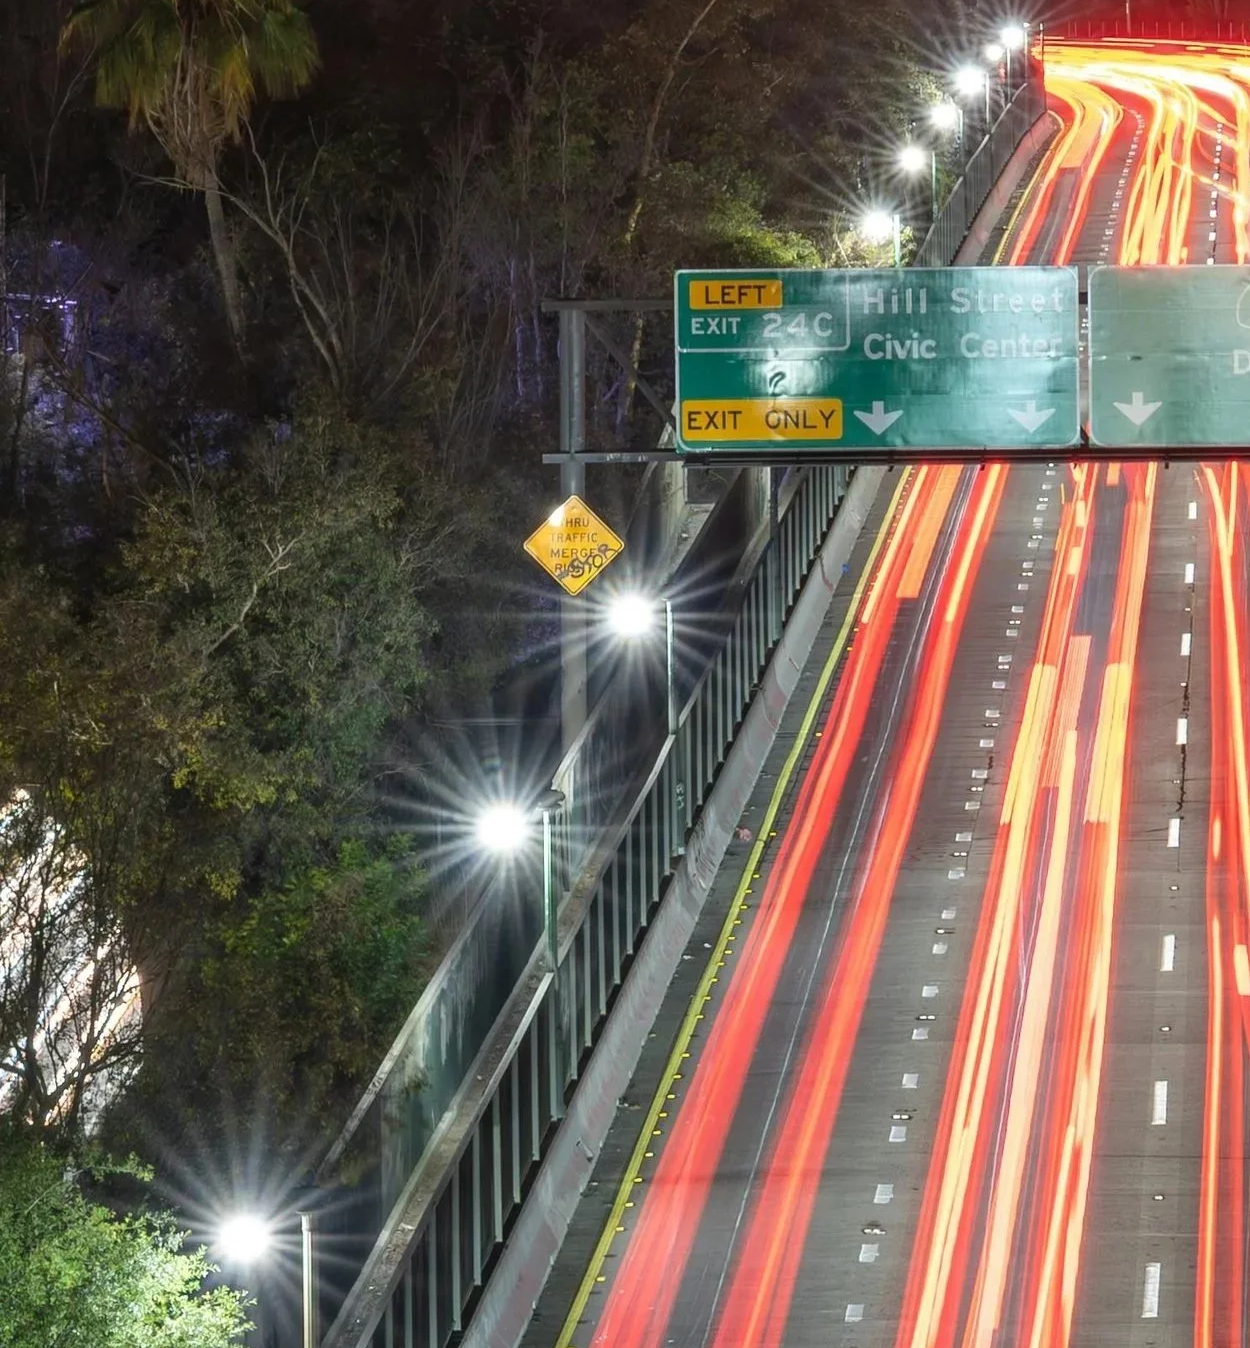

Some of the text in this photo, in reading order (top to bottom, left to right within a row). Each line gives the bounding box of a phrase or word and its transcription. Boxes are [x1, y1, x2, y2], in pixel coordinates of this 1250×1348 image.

[704, 285, 766, 304] LEFT
[863, 286, 1064, 315] Hill Street
[691, 312, 833, 337] EXIT 24C
[863, 331, 1064, 360] Civic Center
[687, 409, 837, 430] EXIT ONLY
[558, 517, 589, 527] HRU
[551, 533, 598, 543] TRAFFIC
[550, 548, 597, 558] MERGE
